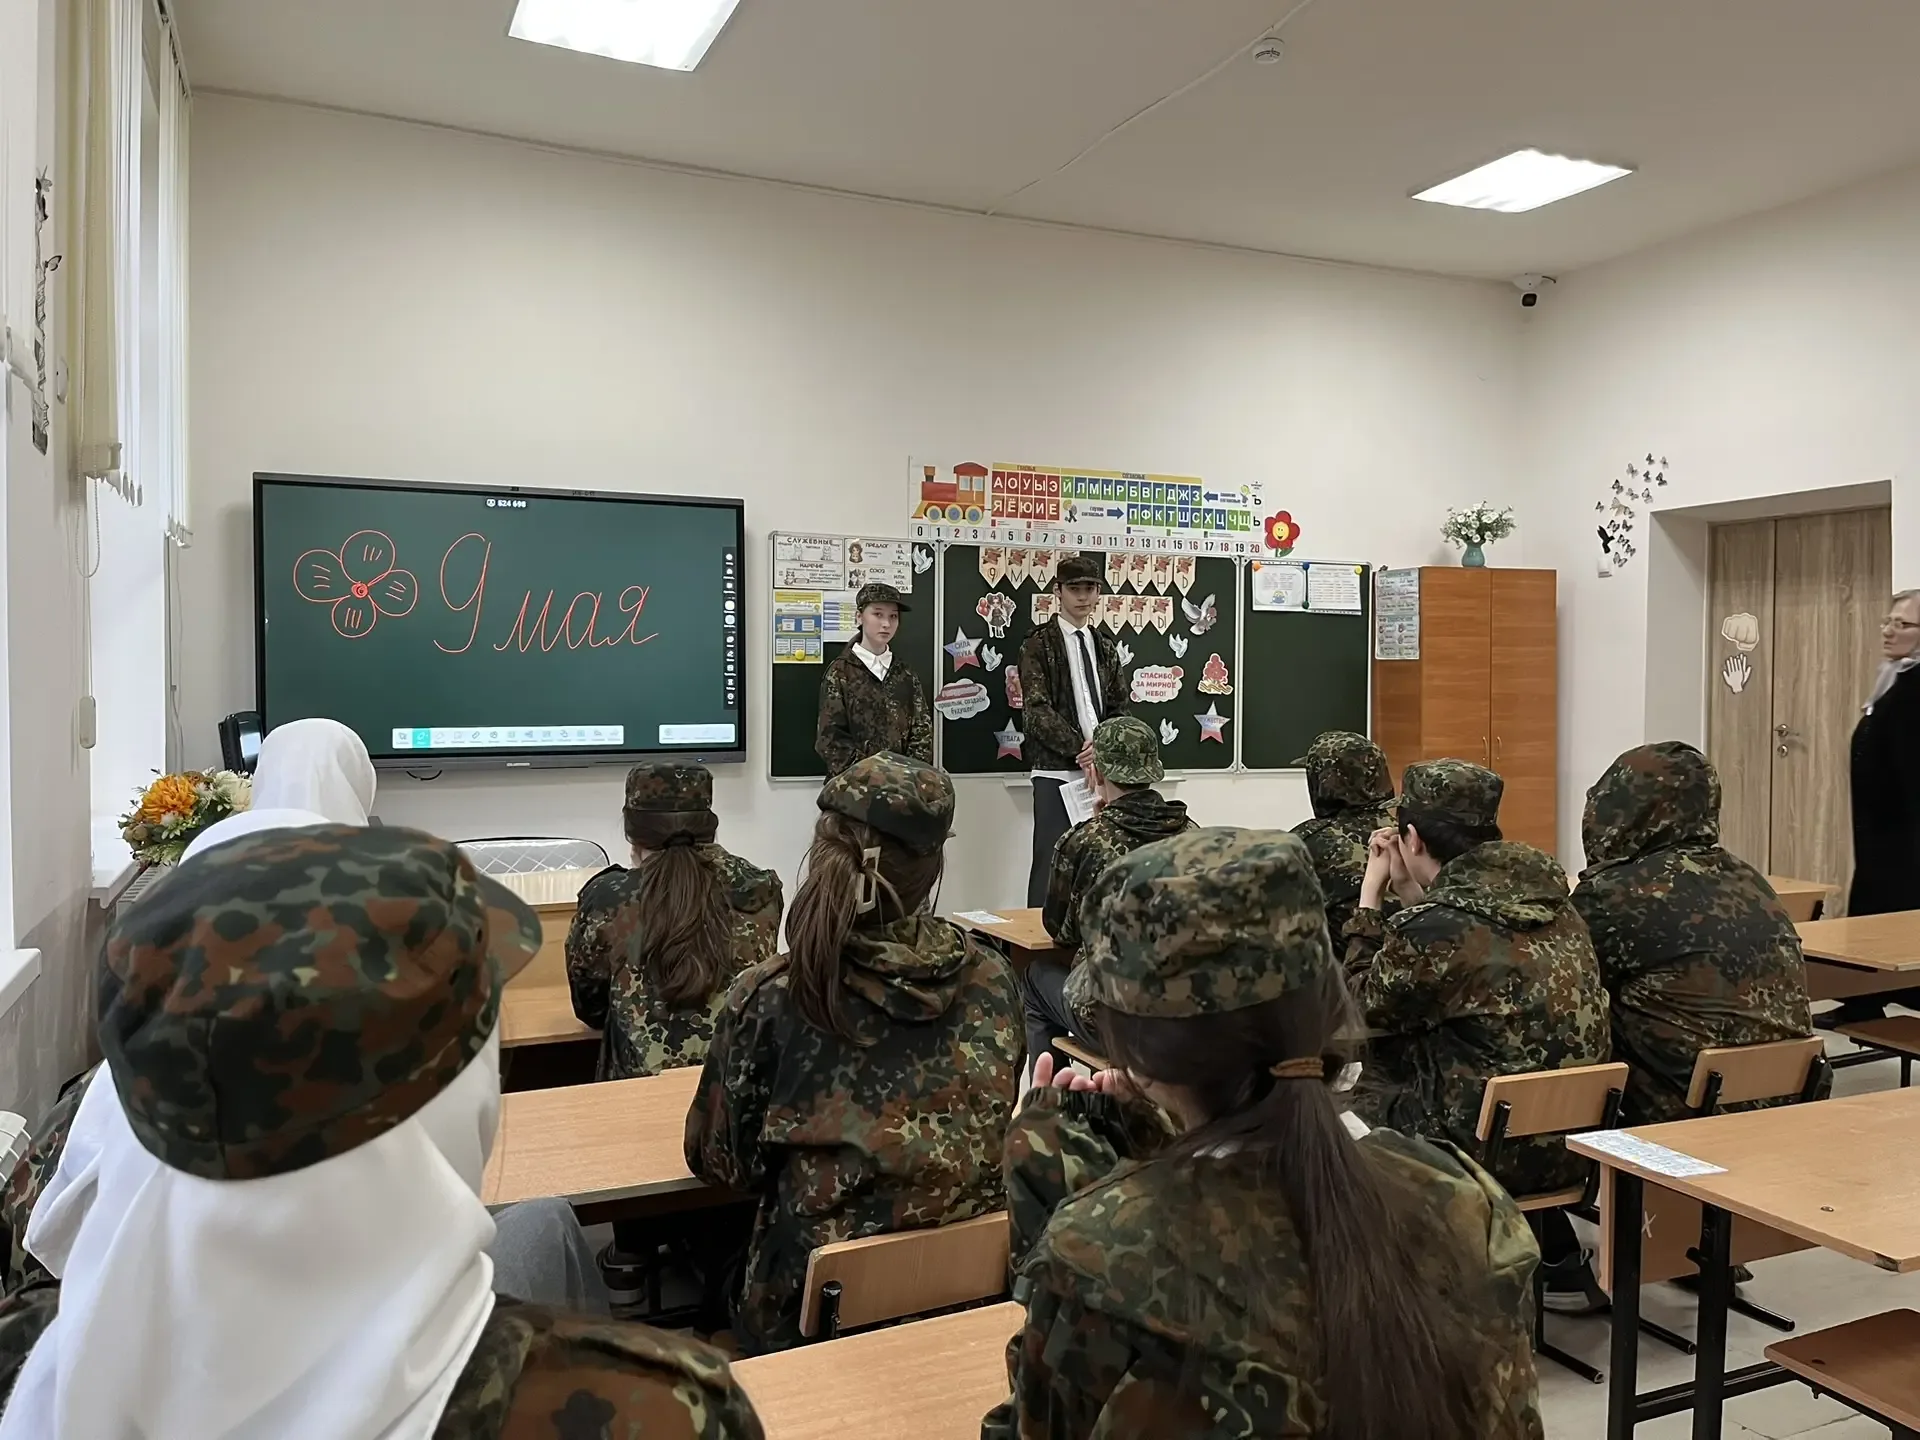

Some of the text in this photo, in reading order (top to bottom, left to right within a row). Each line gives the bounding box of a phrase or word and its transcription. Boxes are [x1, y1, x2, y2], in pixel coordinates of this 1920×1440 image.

[917, 526, 1260, 553] 0 1 2 3 4 5 6 7 8 9 10 11 12 13 14 15 16 17 18 19 20
[990, 567, 996, 582] 9
[1111, 572, 1188, 589] ДЕНЬ
[433, 533, 491, 653] 9
[493, 586, 659, 653] мая
[1038, 613, 1167, 628] ПБЕДЫ
[954, 640, 971, 650] СИЛА
